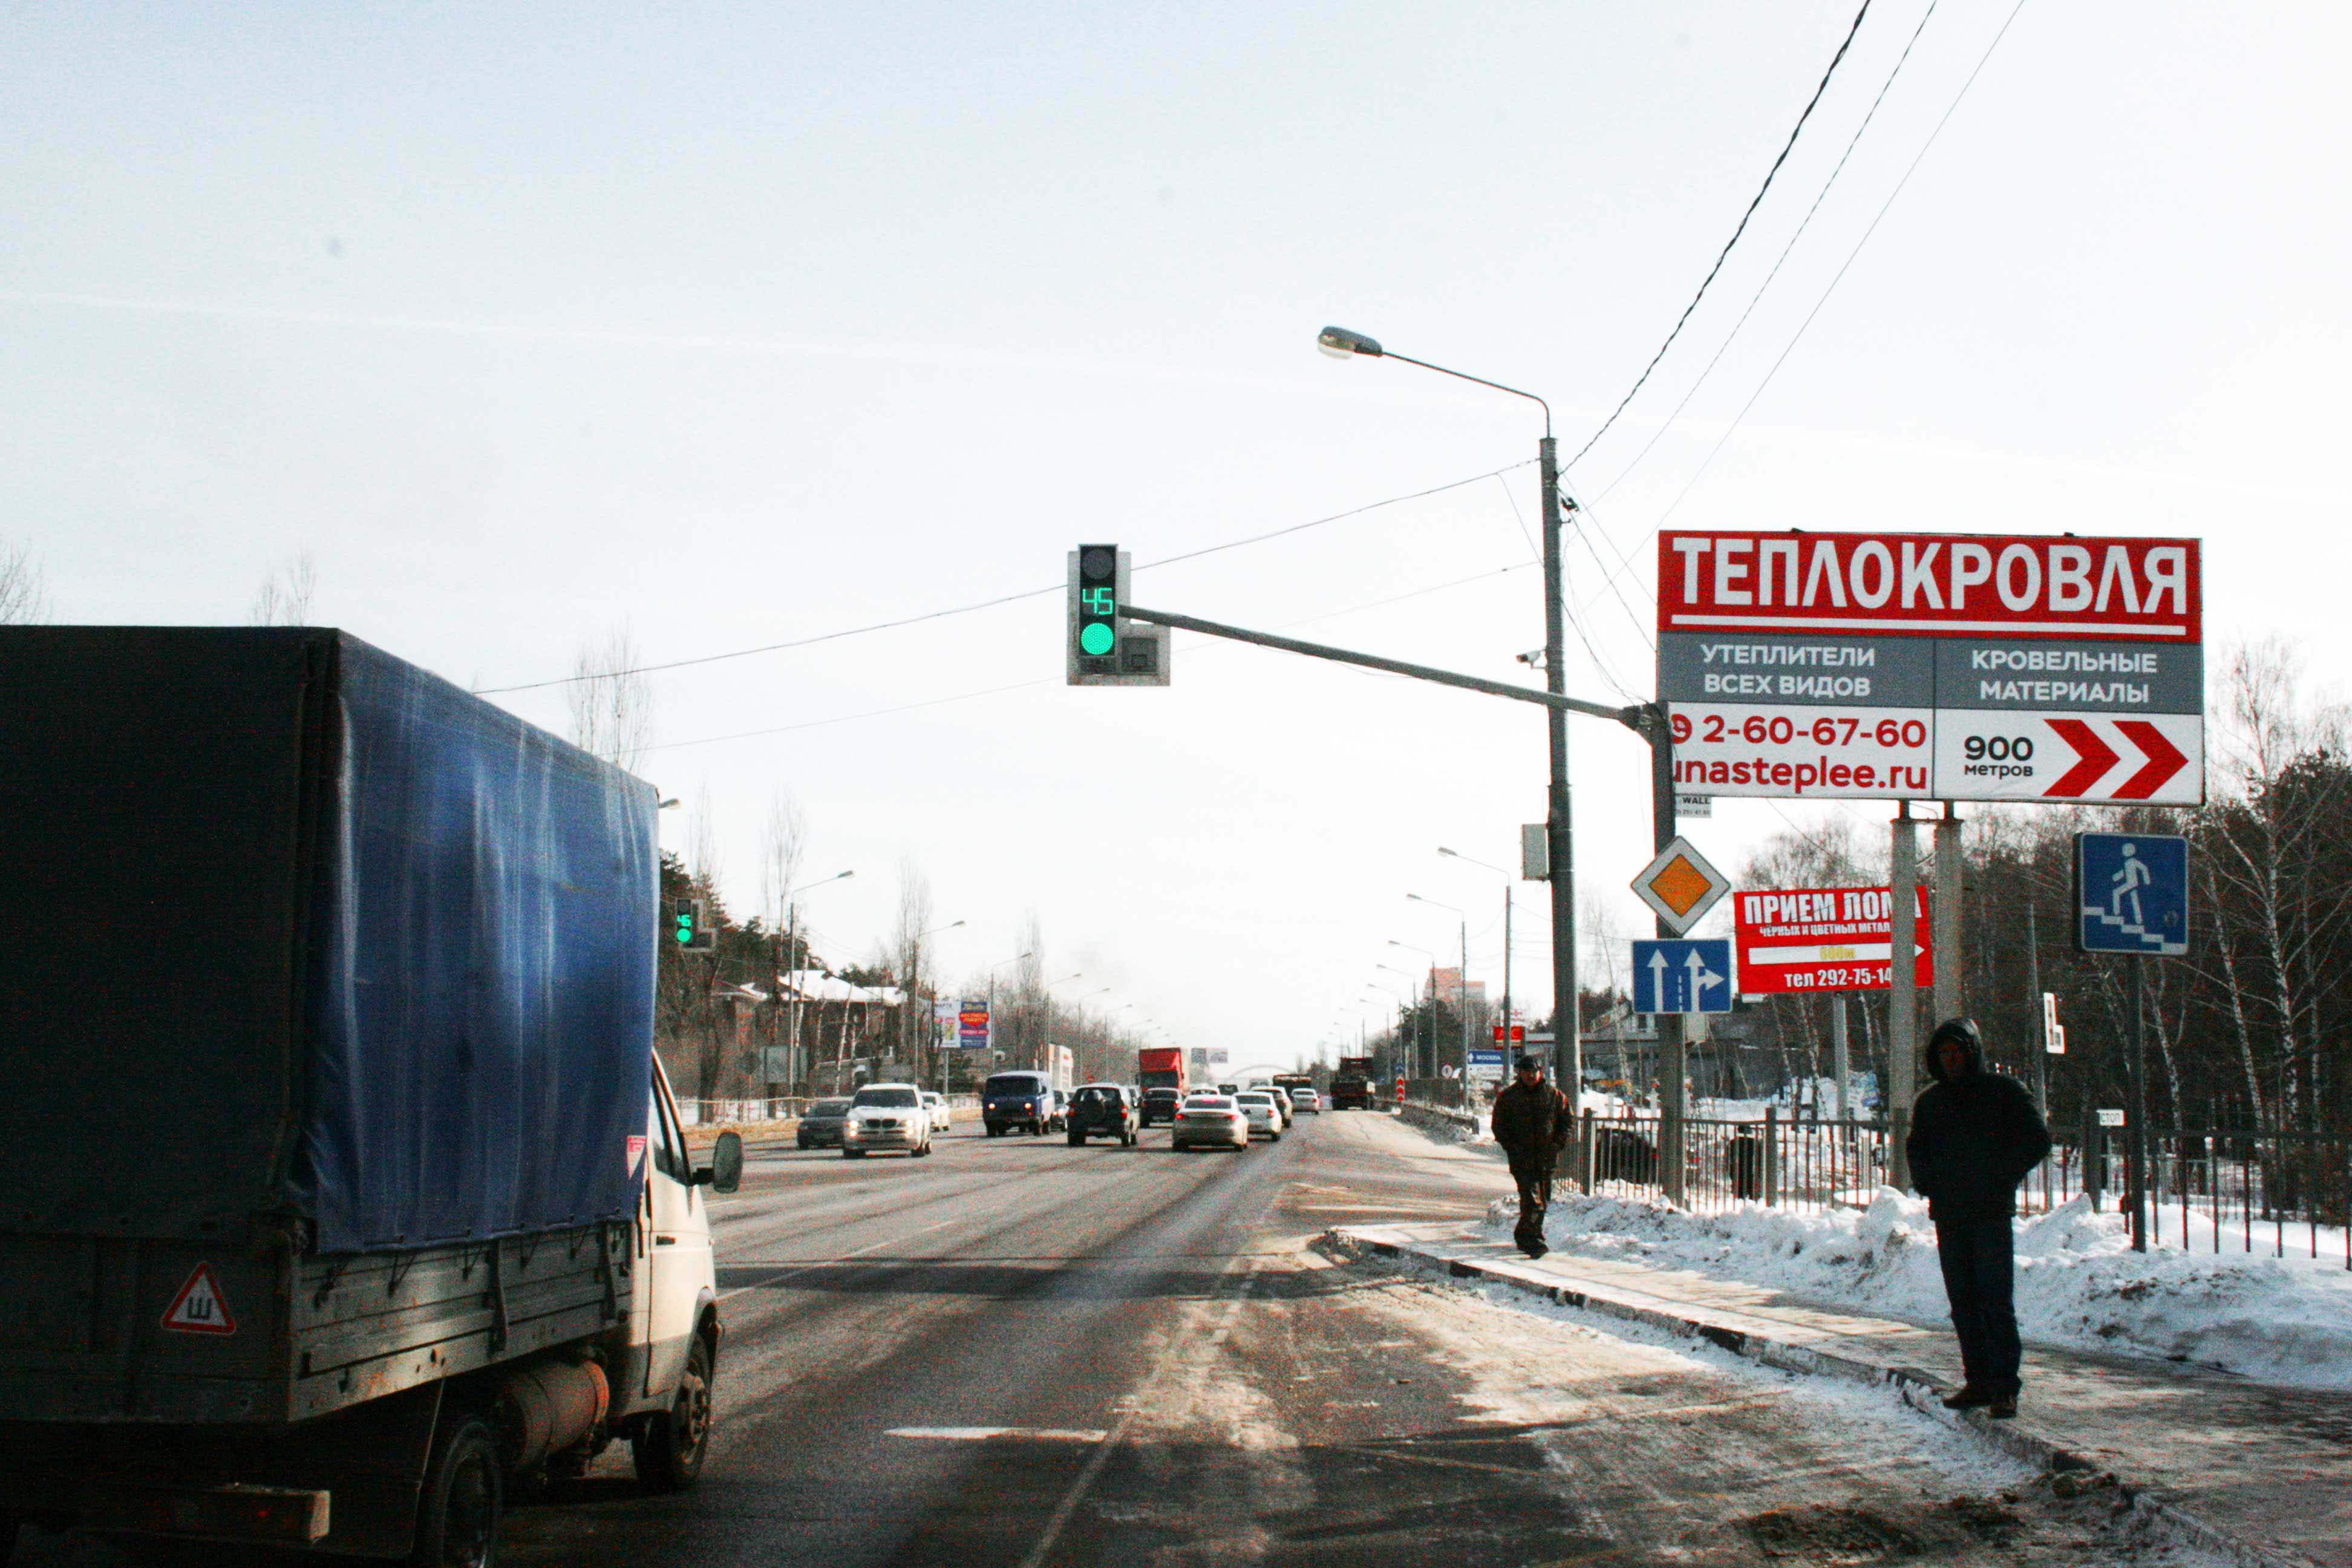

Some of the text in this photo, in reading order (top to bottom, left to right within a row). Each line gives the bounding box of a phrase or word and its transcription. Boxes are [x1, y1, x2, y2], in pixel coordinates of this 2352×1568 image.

[1673, 537, 2186, 615] ТЕПЛОКРОВЛЯ
[1082, 587, 1114, 615] 45
[1700, 644, 1875, 667] УТЕПЛИТЕЛИ
[1971, 650, 2158, 673] КРОВЕЛЬНЫЕ
[1705, 673, 1871, 698] ВСЕХ ВИДОВ
[1980, 680, 2149, 704] МАТЕРИАЛЫ
[1703, 714, 1927, 748] 2-60-67-60
[1964, 736, 2033, 761] 900
[1964, 765, 2033, 780] метров
[1743, 893, 1837, 924] ПРИЕМ
[1811, 923, 1857, 936] ЦВЕТНЫХ
[1784, 972, 1814, 987] тел
[188, 1296, 212, 1319] Ш
